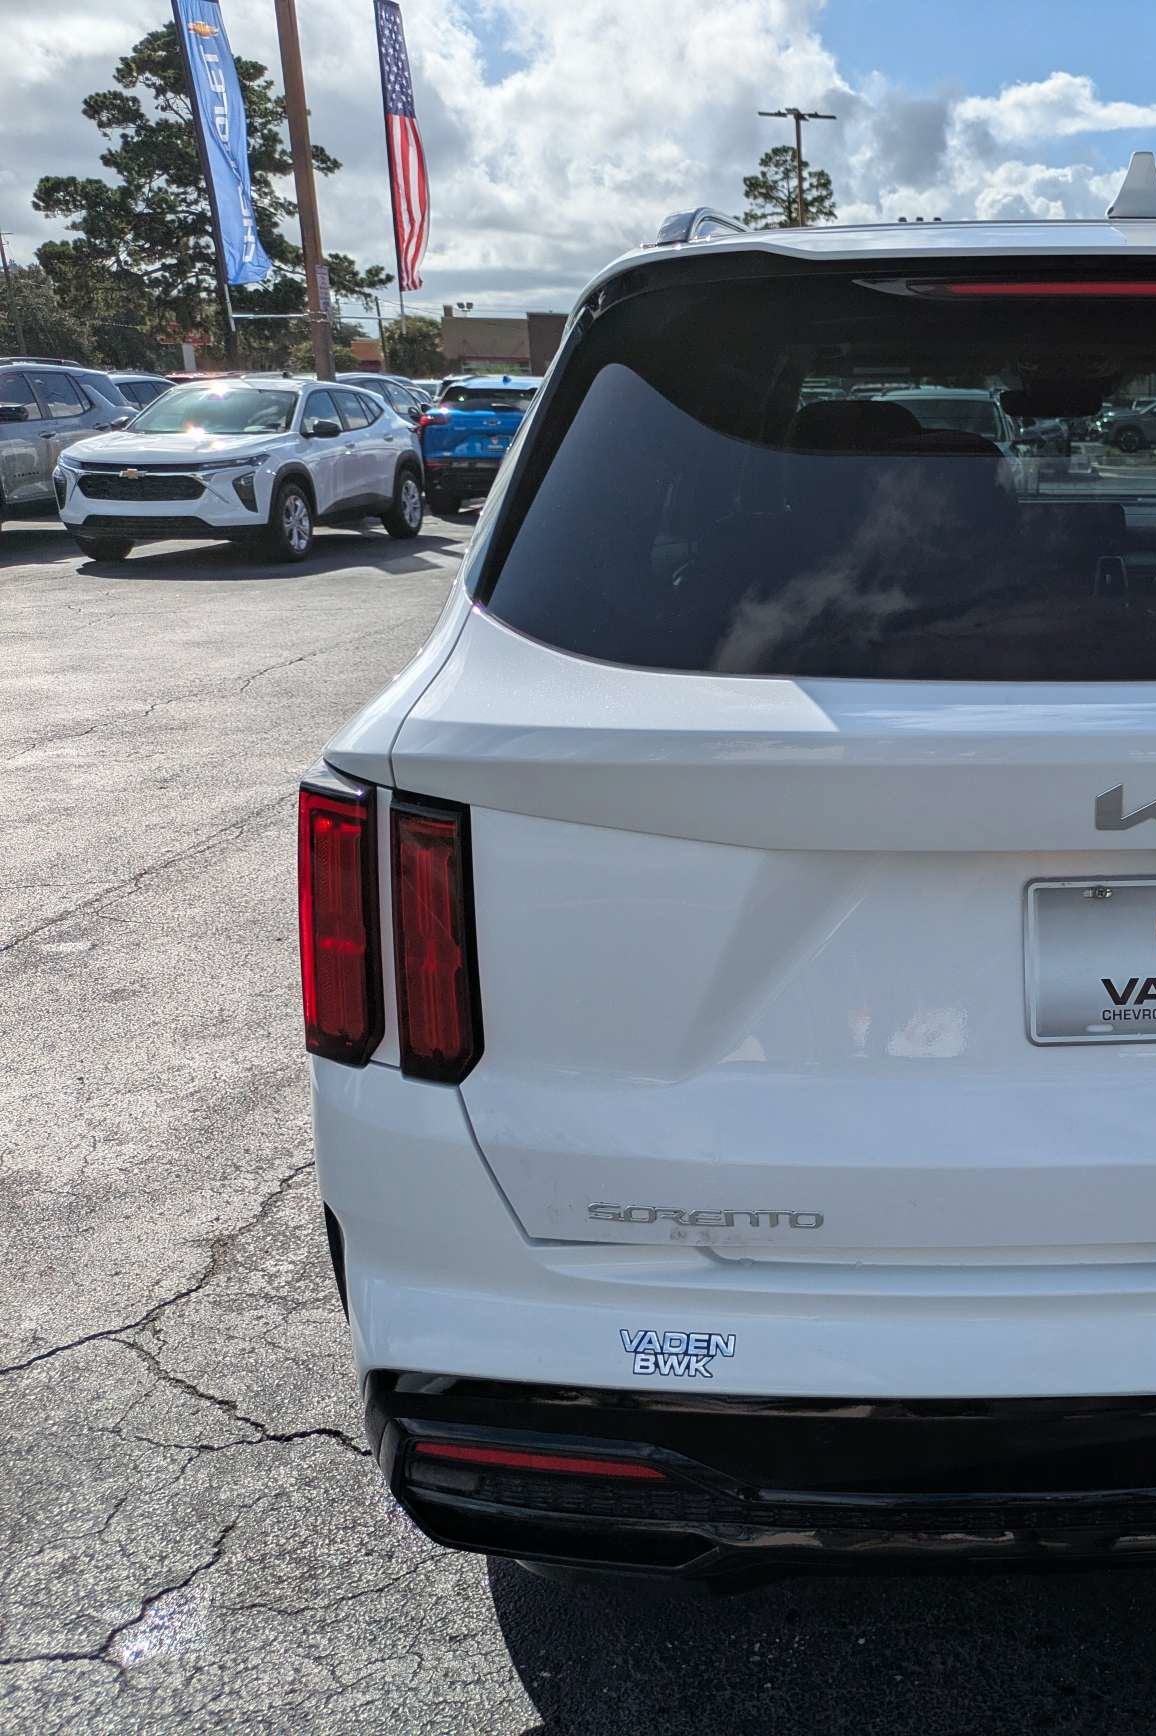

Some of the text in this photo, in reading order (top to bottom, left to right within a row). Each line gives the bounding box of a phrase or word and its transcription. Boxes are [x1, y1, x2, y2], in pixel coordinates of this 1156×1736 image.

[586, 1201, 825, 1230] SORENTO
[619, 1328, 737, 1358] VADEN
[632, 1351, 714, 1379] BWK
